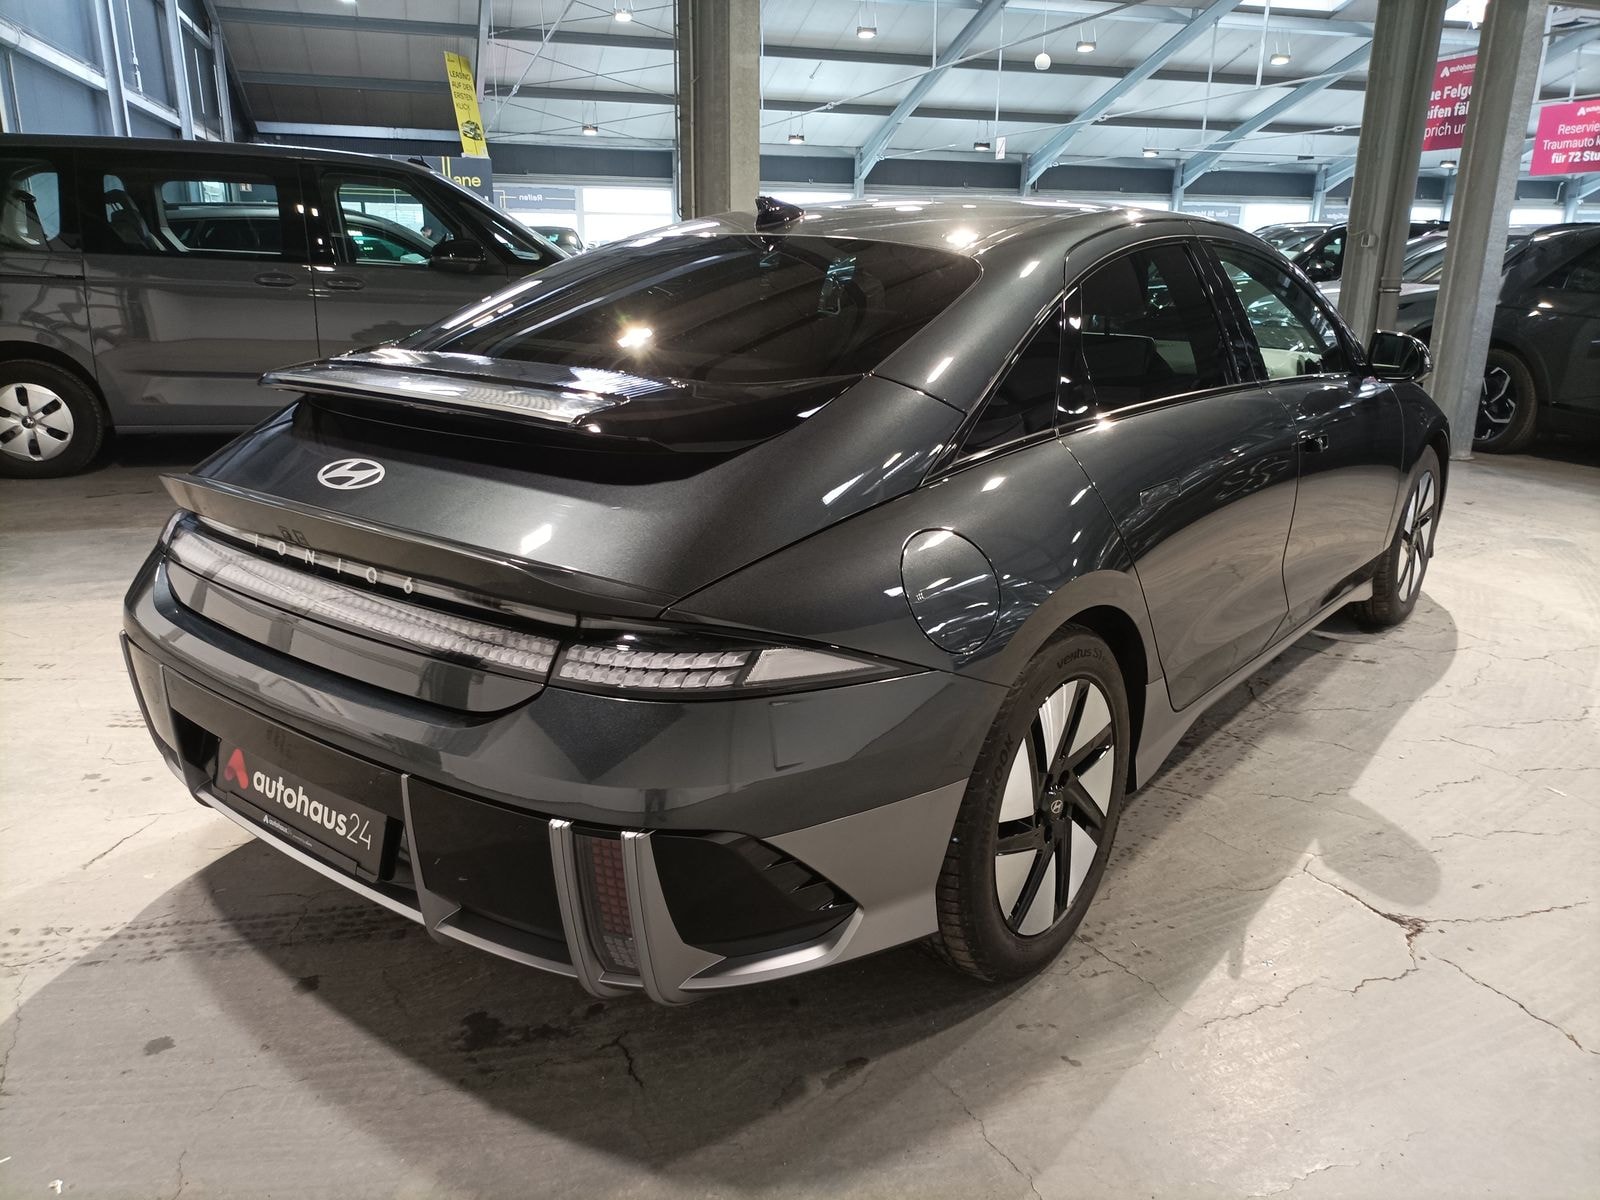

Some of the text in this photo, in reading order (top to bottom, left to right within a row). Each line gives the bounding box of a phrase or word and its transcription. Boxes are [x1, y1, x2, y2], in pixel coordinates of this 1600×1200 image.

[1424, 122, 1451, 140] prich
[1557, 121, 1600, 135] Reservie
[1543, 137, 1595, 150] Traumauto
[1551, 149, 1600, 164] für 72 Stu
[254, 533, 413, 595] IONIQ 6
